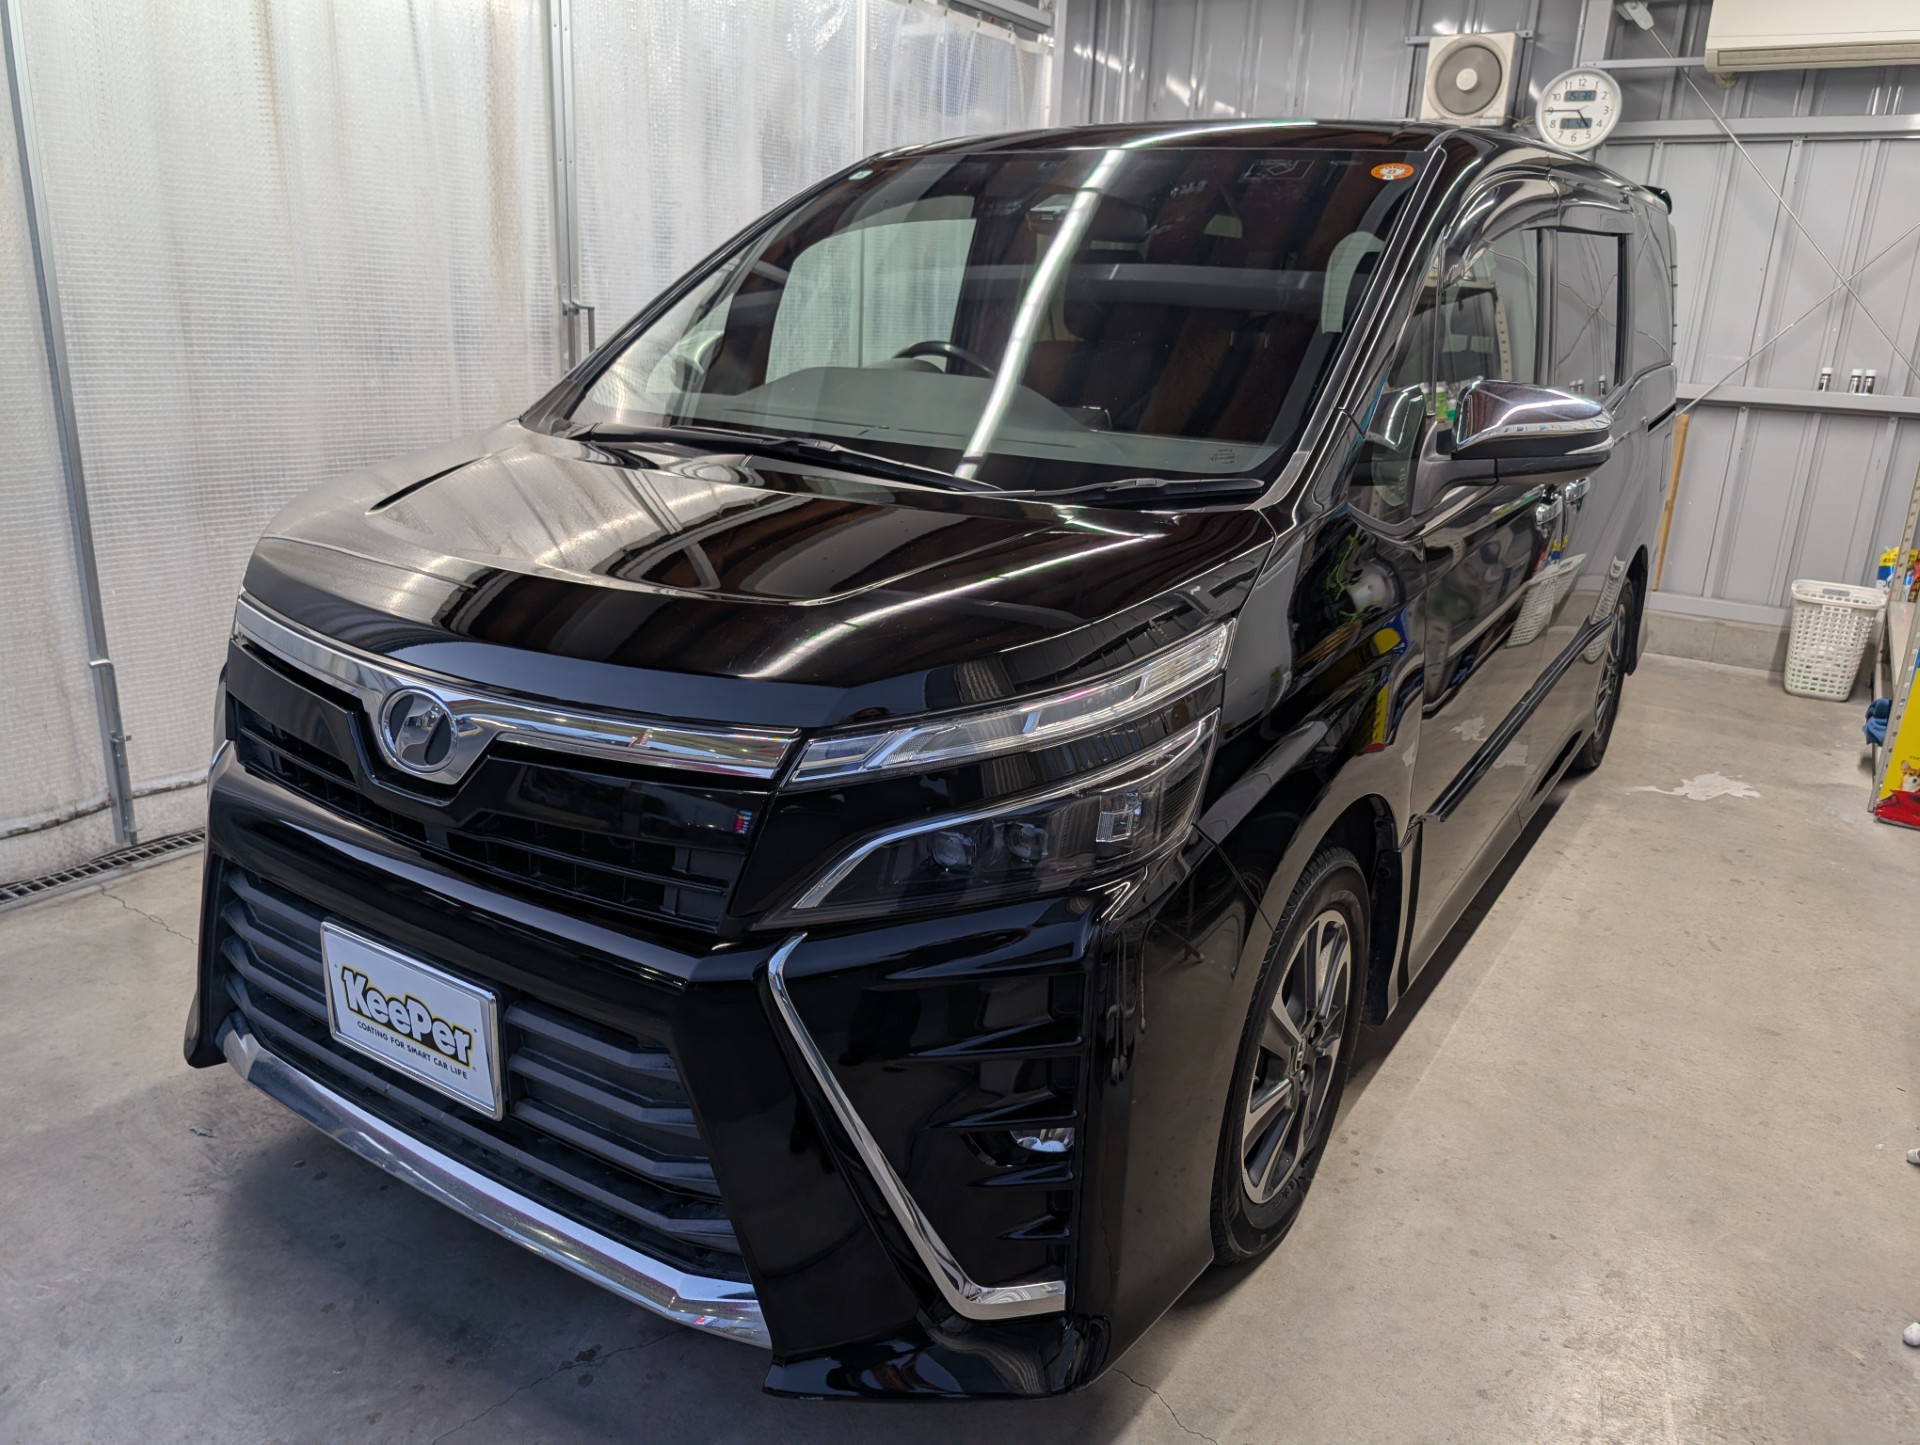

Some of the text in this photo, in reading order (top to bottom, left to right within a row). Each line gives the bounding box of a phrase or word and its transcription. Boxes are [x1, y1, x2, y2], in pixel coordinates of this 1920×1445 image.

[1565, 81, 1573, 89] 11
[1579, 79, 1587, 87] 12
[1552, 93, 1561, 101] 10
[1601, 92, 1608, 100] 2
[1547, 106, 1554, 116] 9
[1603, 106, 1609, 114] 3
[1549, 120, 1556, 128] 8
[1558, 131, 1564, 139] 7
[1571, 134, 1577, 142] 6
[1586, 131, 1591, 139] 5
[341, 966, 472, 1067] KeePer
[357, 1020, 468, 1080] COATING FOR SMART CAR LIFE
